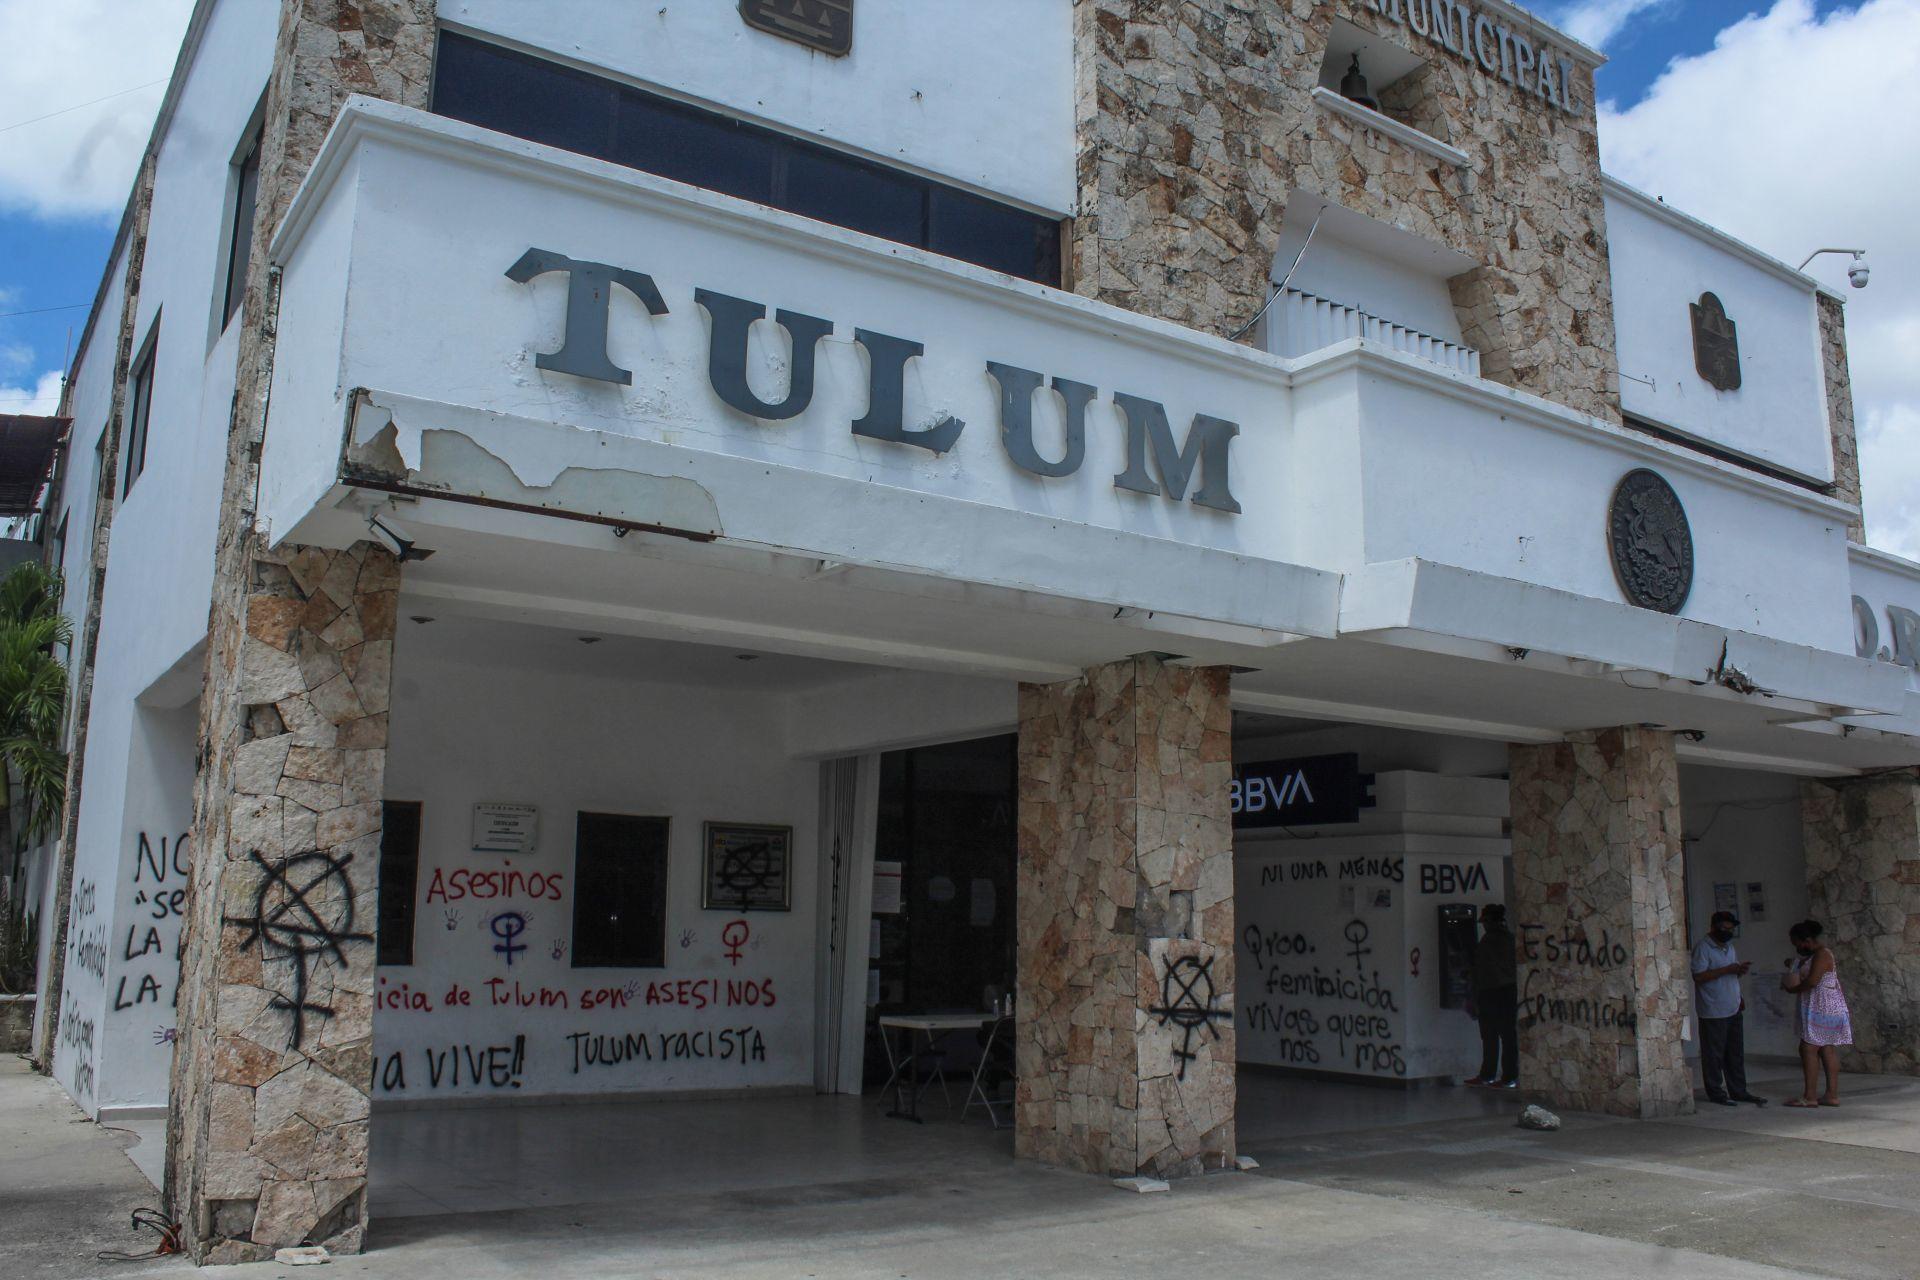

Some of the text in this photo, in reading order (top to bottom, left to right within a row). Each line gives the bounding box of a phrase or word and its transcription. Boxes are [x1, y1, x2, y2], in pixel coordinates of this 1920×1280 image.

[504, 247, 1241, 514] TULUM
[1231, 768, 1314, 813] BBVA
[1261, 856, 1404, 886] NI UNA MENOS
[1420, 861, 1490, 894] BBVA
[125, 924, 162, 961] LA
[1519, 923, 1626, 968] Estado
[114, 974, 162, 1011] LA
[444, 984, 471, 1006] de
[483, 977, 568, 1009] Tulum
[580, 986, 627, 1009] son
[646, 978, 776, 1010] ASESINOS
[1266, 965, 1398, 1013] feminicida
[567, 1031, 652, 1074] TULUM
[1279, 1037, 1407, 1076] nos mos
